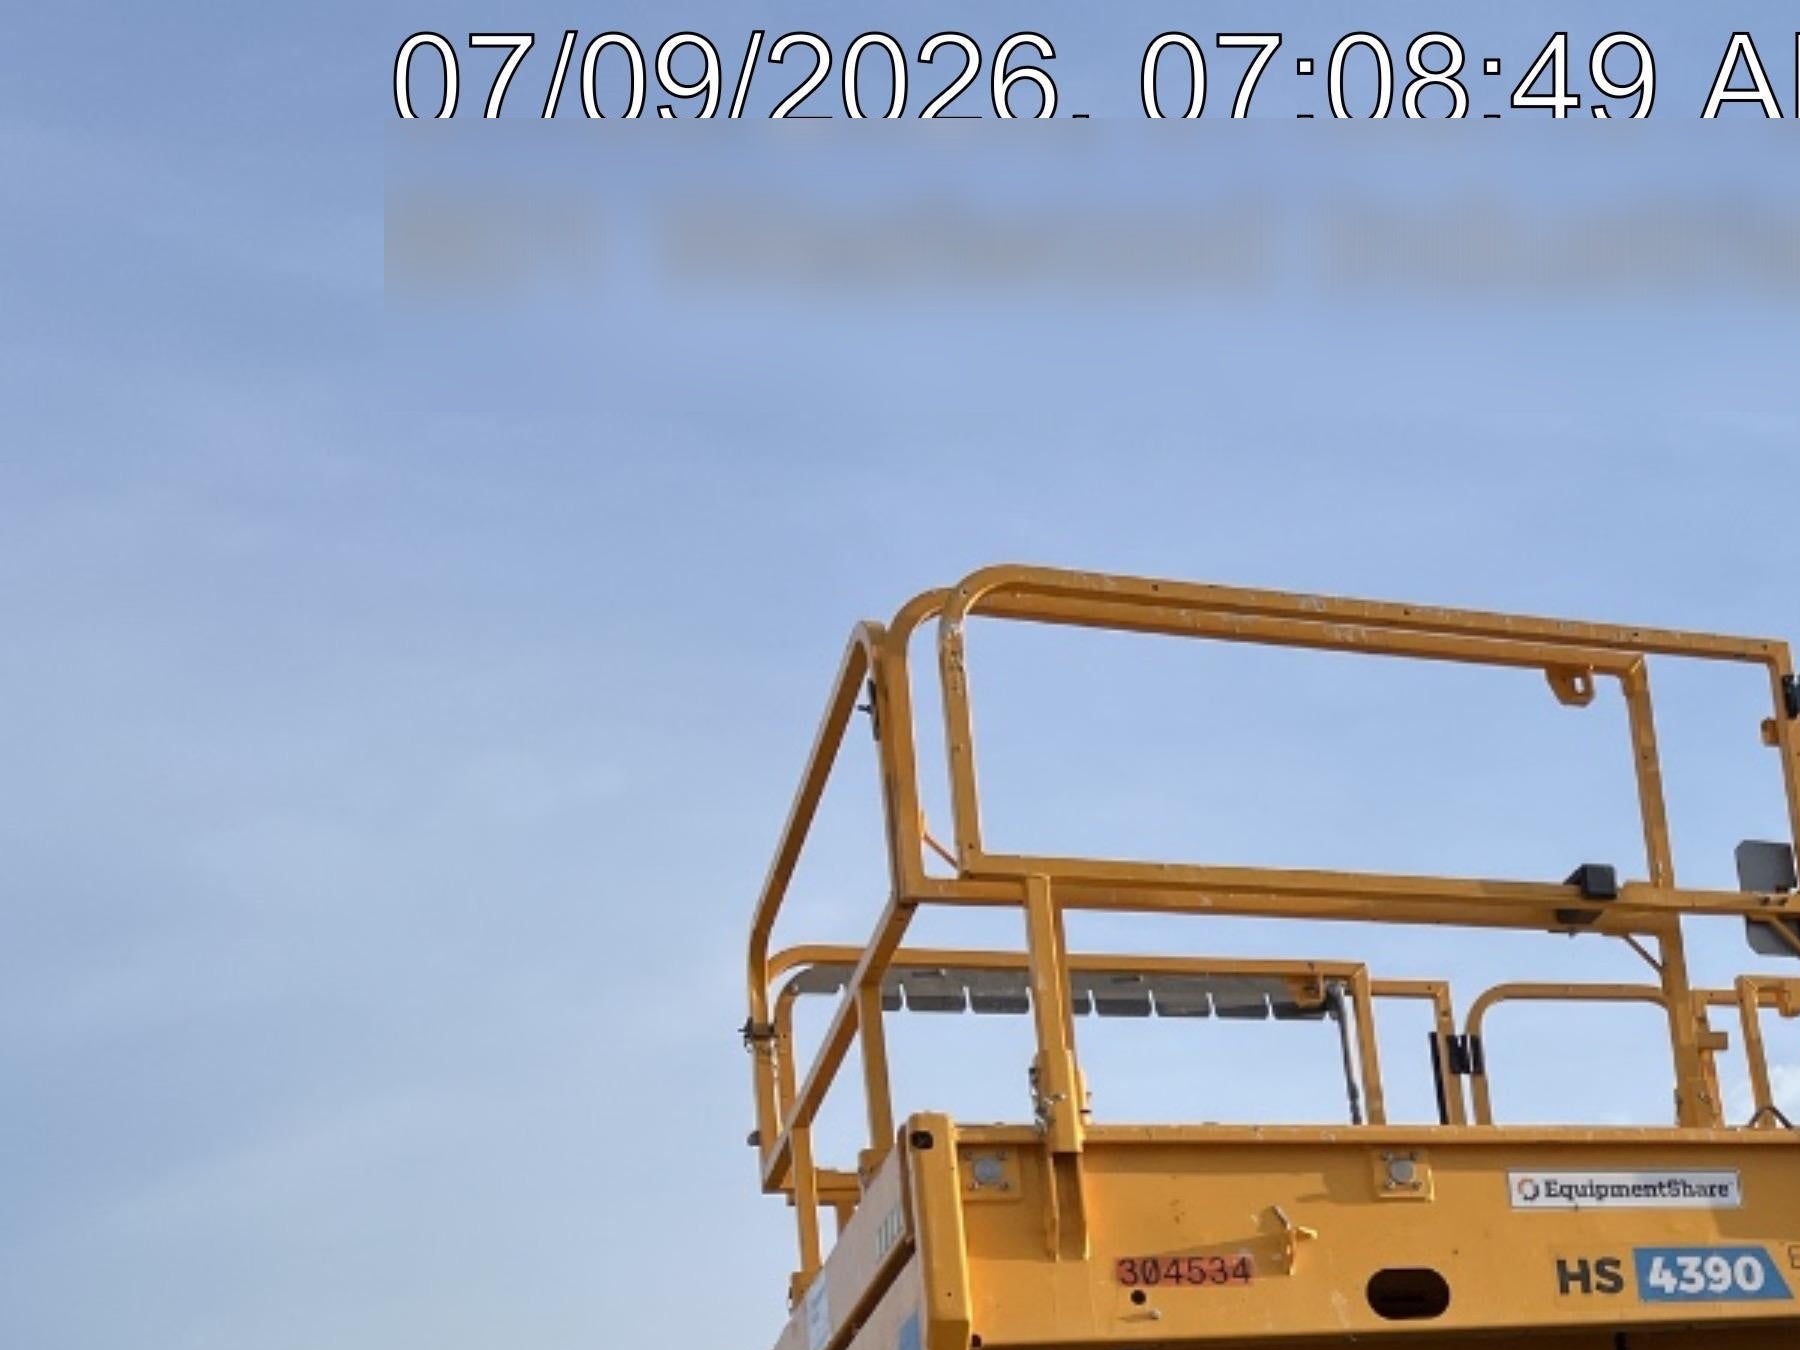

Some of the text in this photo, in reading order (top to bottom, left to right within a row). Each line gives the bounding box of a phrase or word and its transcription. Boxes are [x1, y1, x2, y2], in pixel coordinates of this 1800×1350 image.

[1544, 1177, 1730, 1201] EquipmentShare
[1117, 1256, 1252, 1286] 304534
[1556, 1257, 1624, 1295] HS
[1649, 1255, 1765, 1294] 4390
